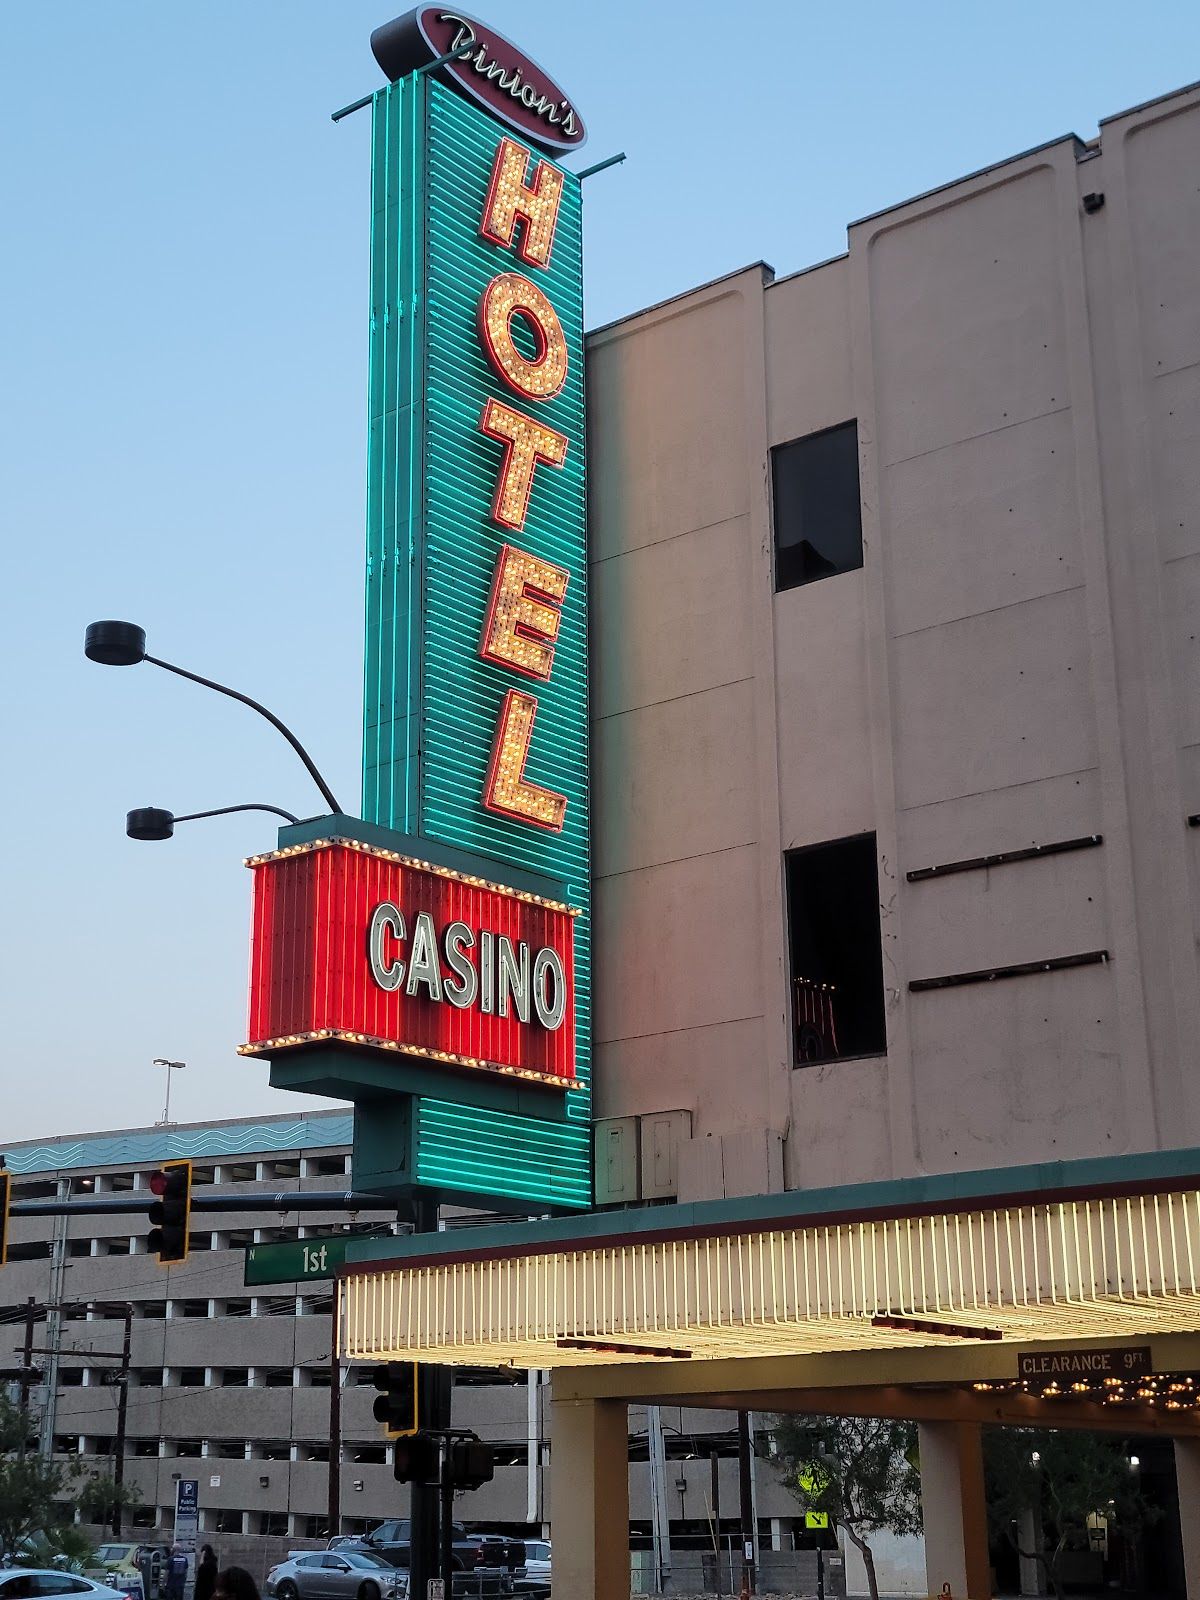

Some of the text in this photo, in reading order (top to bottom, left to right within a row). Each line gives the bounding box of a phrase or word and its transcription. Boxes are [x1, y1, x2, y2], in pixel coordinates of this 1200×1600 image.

[440, 14, 579, 136] Binion's
[478, 136, 569, 834] HOTEL
[369, 900, 567, 1031] CASINO
[249, 1244, 328, 1273] N 1st
[1022, 1354, 1112, 1374] CLEARANCE
